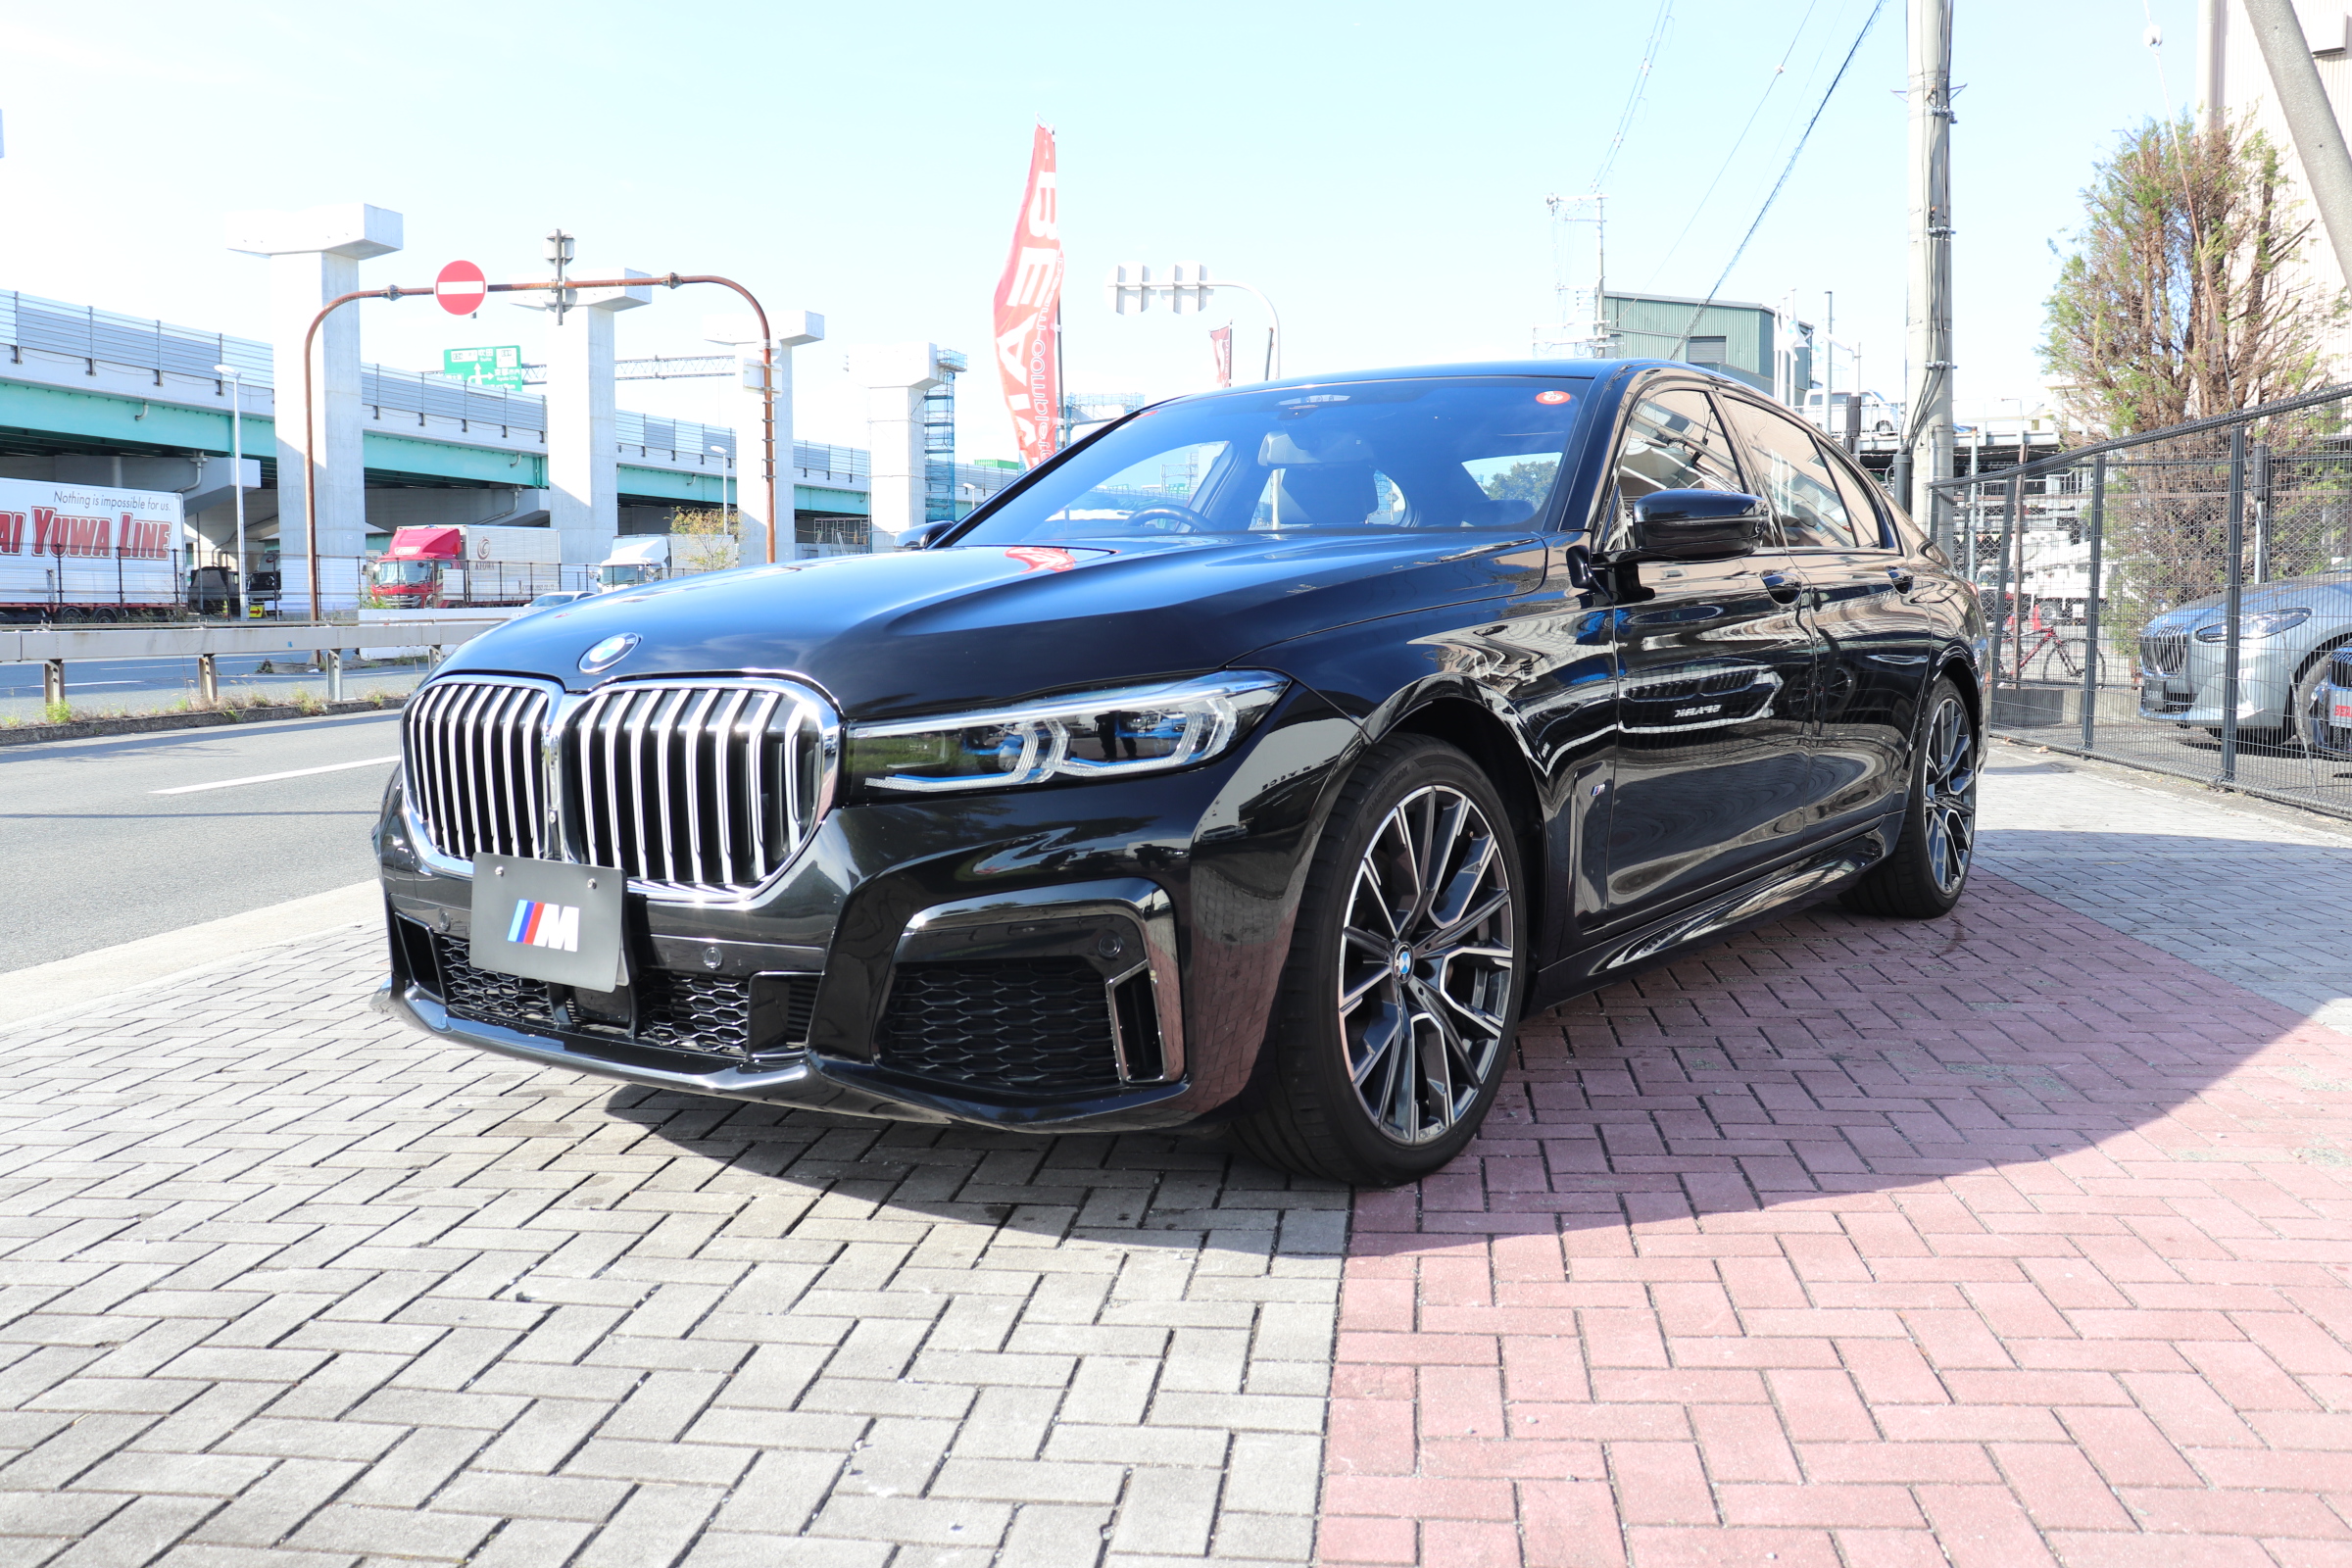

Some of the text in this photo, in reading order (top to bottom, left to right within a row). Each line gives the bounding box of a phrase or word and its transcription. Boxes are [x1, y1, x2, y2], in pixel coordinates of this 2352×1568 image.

[54, 490, 172, 512] Nothing is impossible for us.
[31, 506, 113, 559] YUWA
[117, 512, 172, 561] LINE
